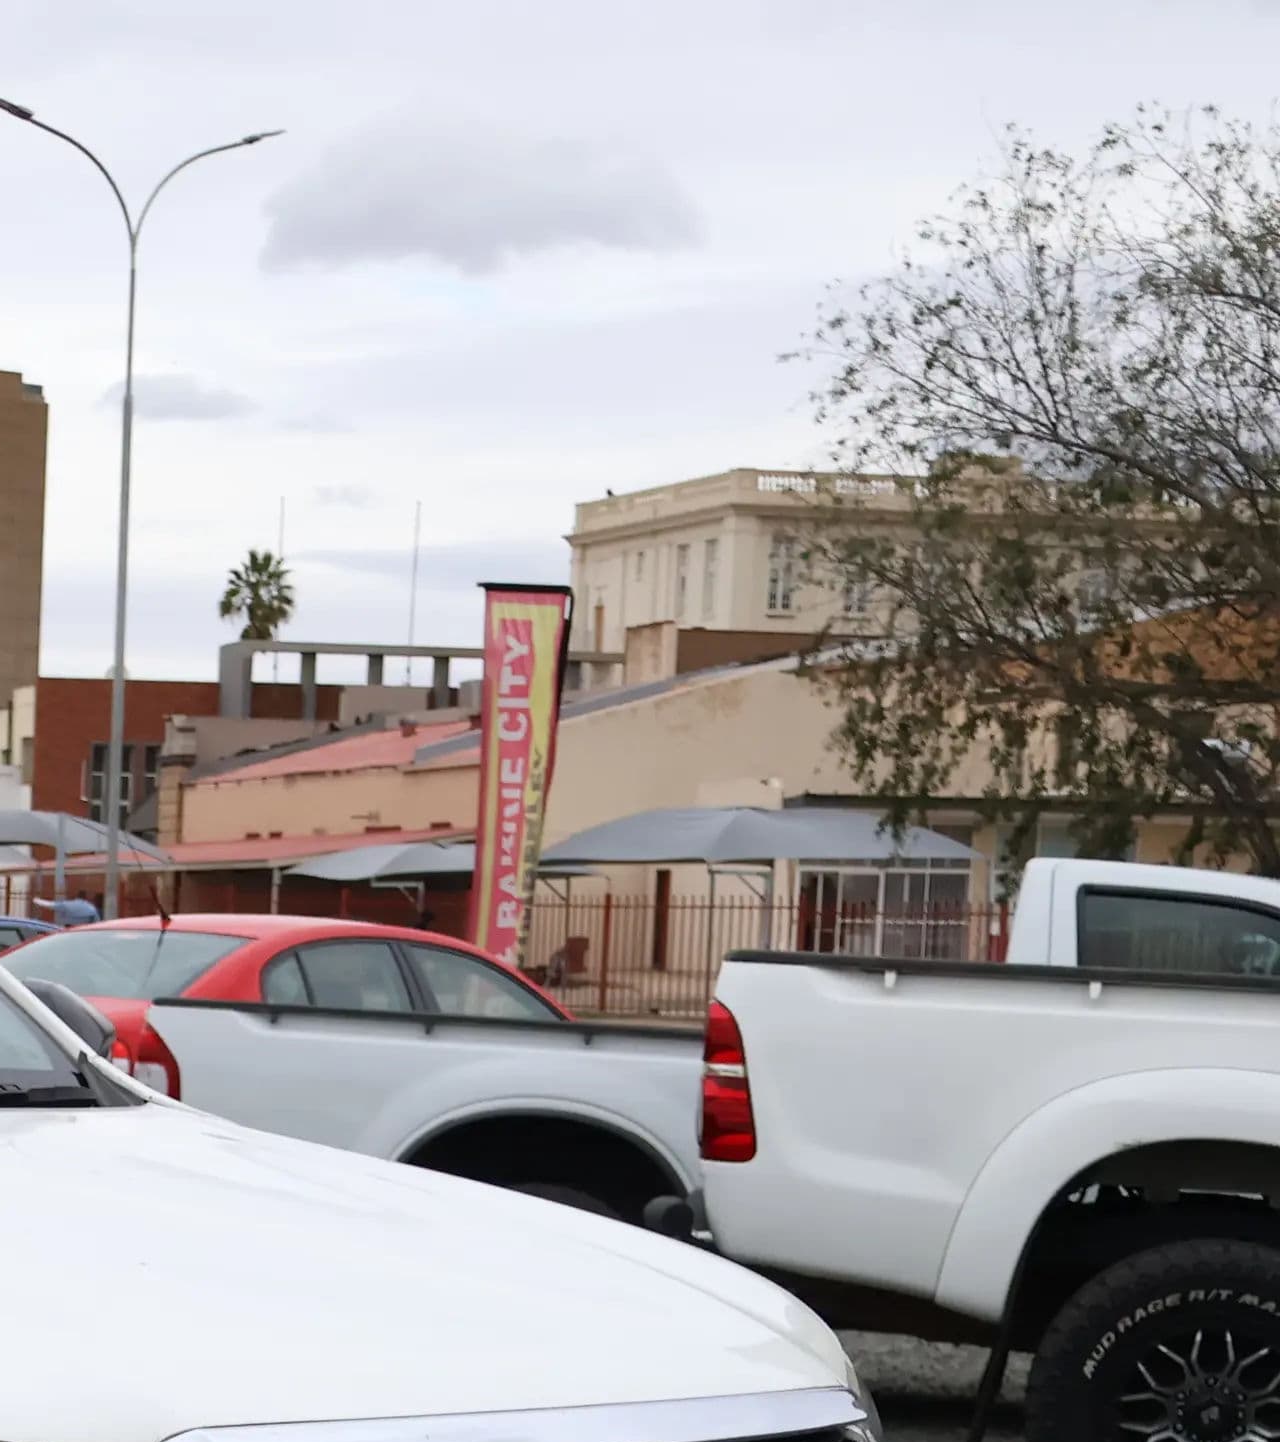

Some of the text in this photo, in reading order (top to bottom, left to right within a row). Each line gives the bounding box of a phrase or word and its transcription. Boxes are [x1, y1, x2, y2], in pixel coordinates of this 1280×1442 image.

[498, 634, 529, 742] CITY
[1083, 1331, 1116, 1379] MUD
[1117, 1292, 1182, 1333] RAGE
